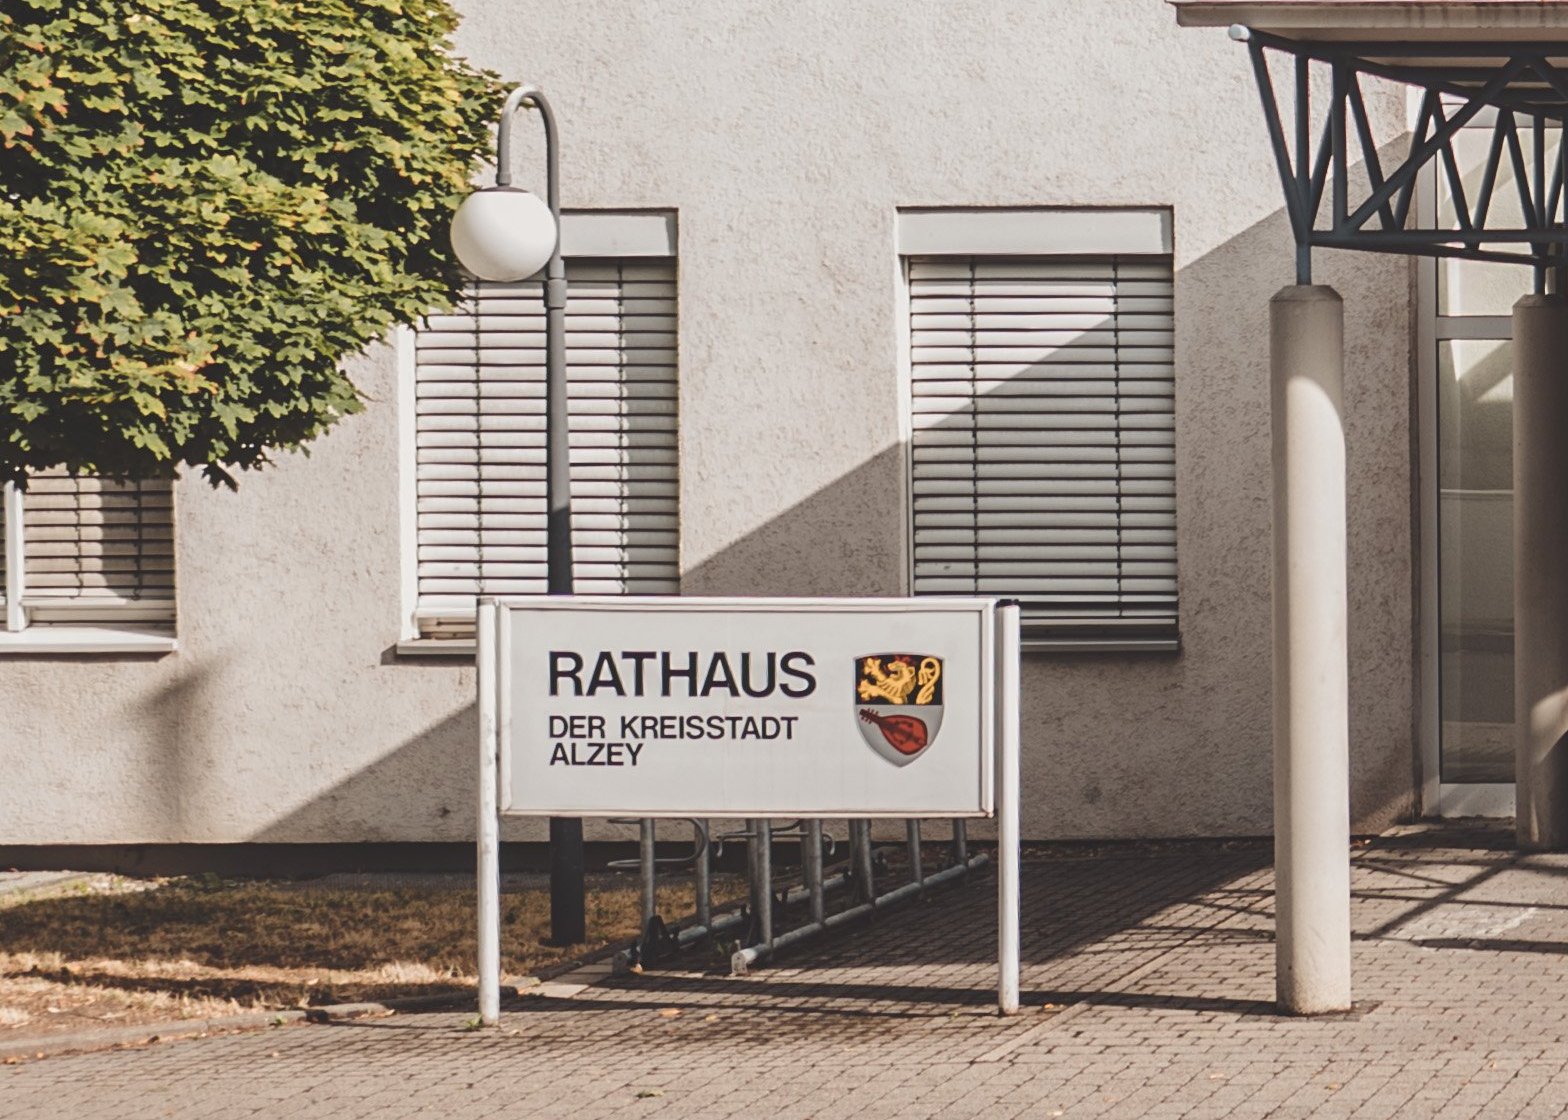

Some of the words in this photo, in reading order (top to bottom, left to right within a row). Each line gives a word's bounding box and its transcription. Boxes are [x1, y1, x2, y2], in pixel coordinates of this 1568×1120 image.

[548, 651, 817, 698] RATHAUS
[549, 716, 605, 739] DER
[620, 716, 799, 740] KREISSTADT
[550, 744, 644, 766] ALZEY
